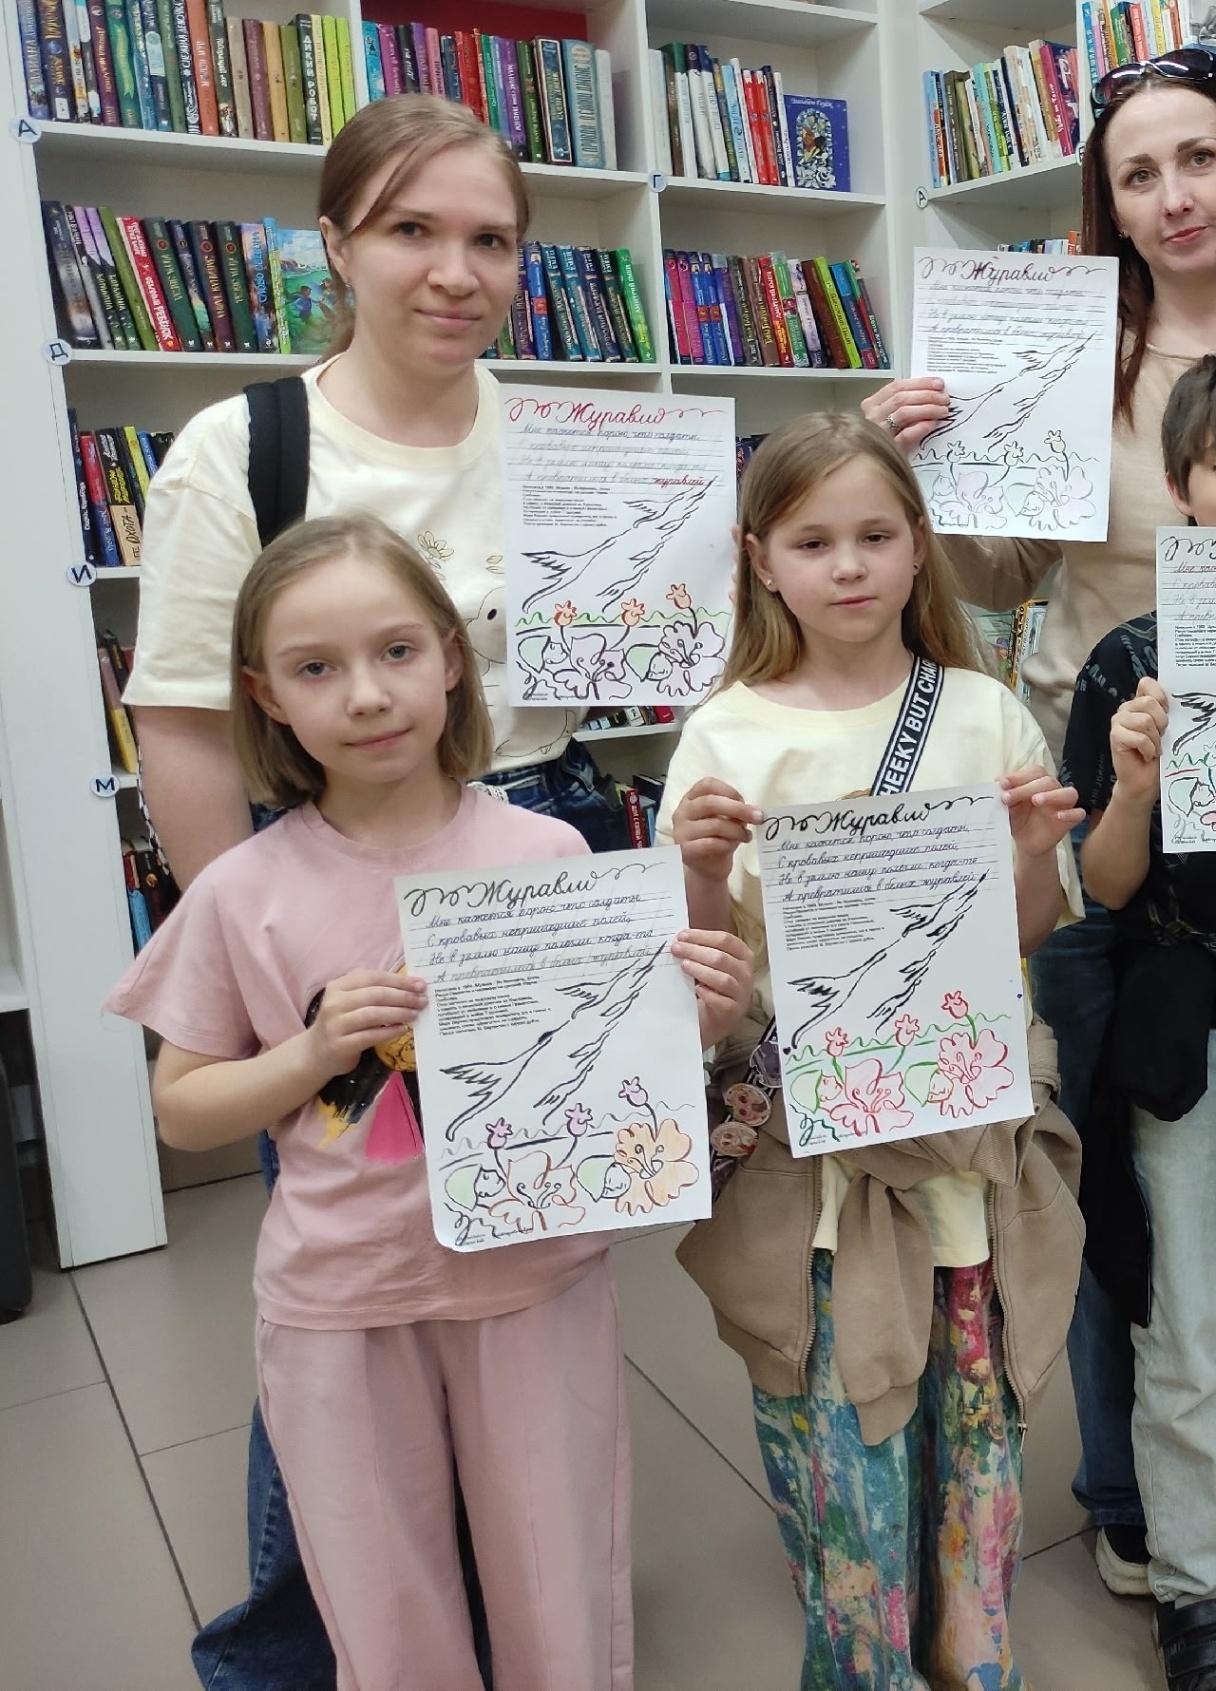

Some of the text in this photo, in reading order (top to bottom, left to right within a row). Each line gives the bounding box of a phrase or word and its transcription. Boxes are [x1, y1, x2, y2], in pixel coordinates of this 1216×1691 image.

[304, 35, 318, 121] ДИКИЙ РОБОТ
[18, 119, 38, 138] А
[653, 174, 662, 188] Г
[960, 261, 1052, 286] Журавли
[49, 342, 69, 363] Д
[557, 402, 666, 431] Журавли
[879, 731, 918, 797] HEEKY
[905, 692, 931, 733] BUT
[95, 777, 116, 793] М
[815, 803, 933, 836] Журавли
[467, 870, 599, 910] Журавли
[438, 927, 496, 948] кровавых
[429, 947, 445, 965] Не
